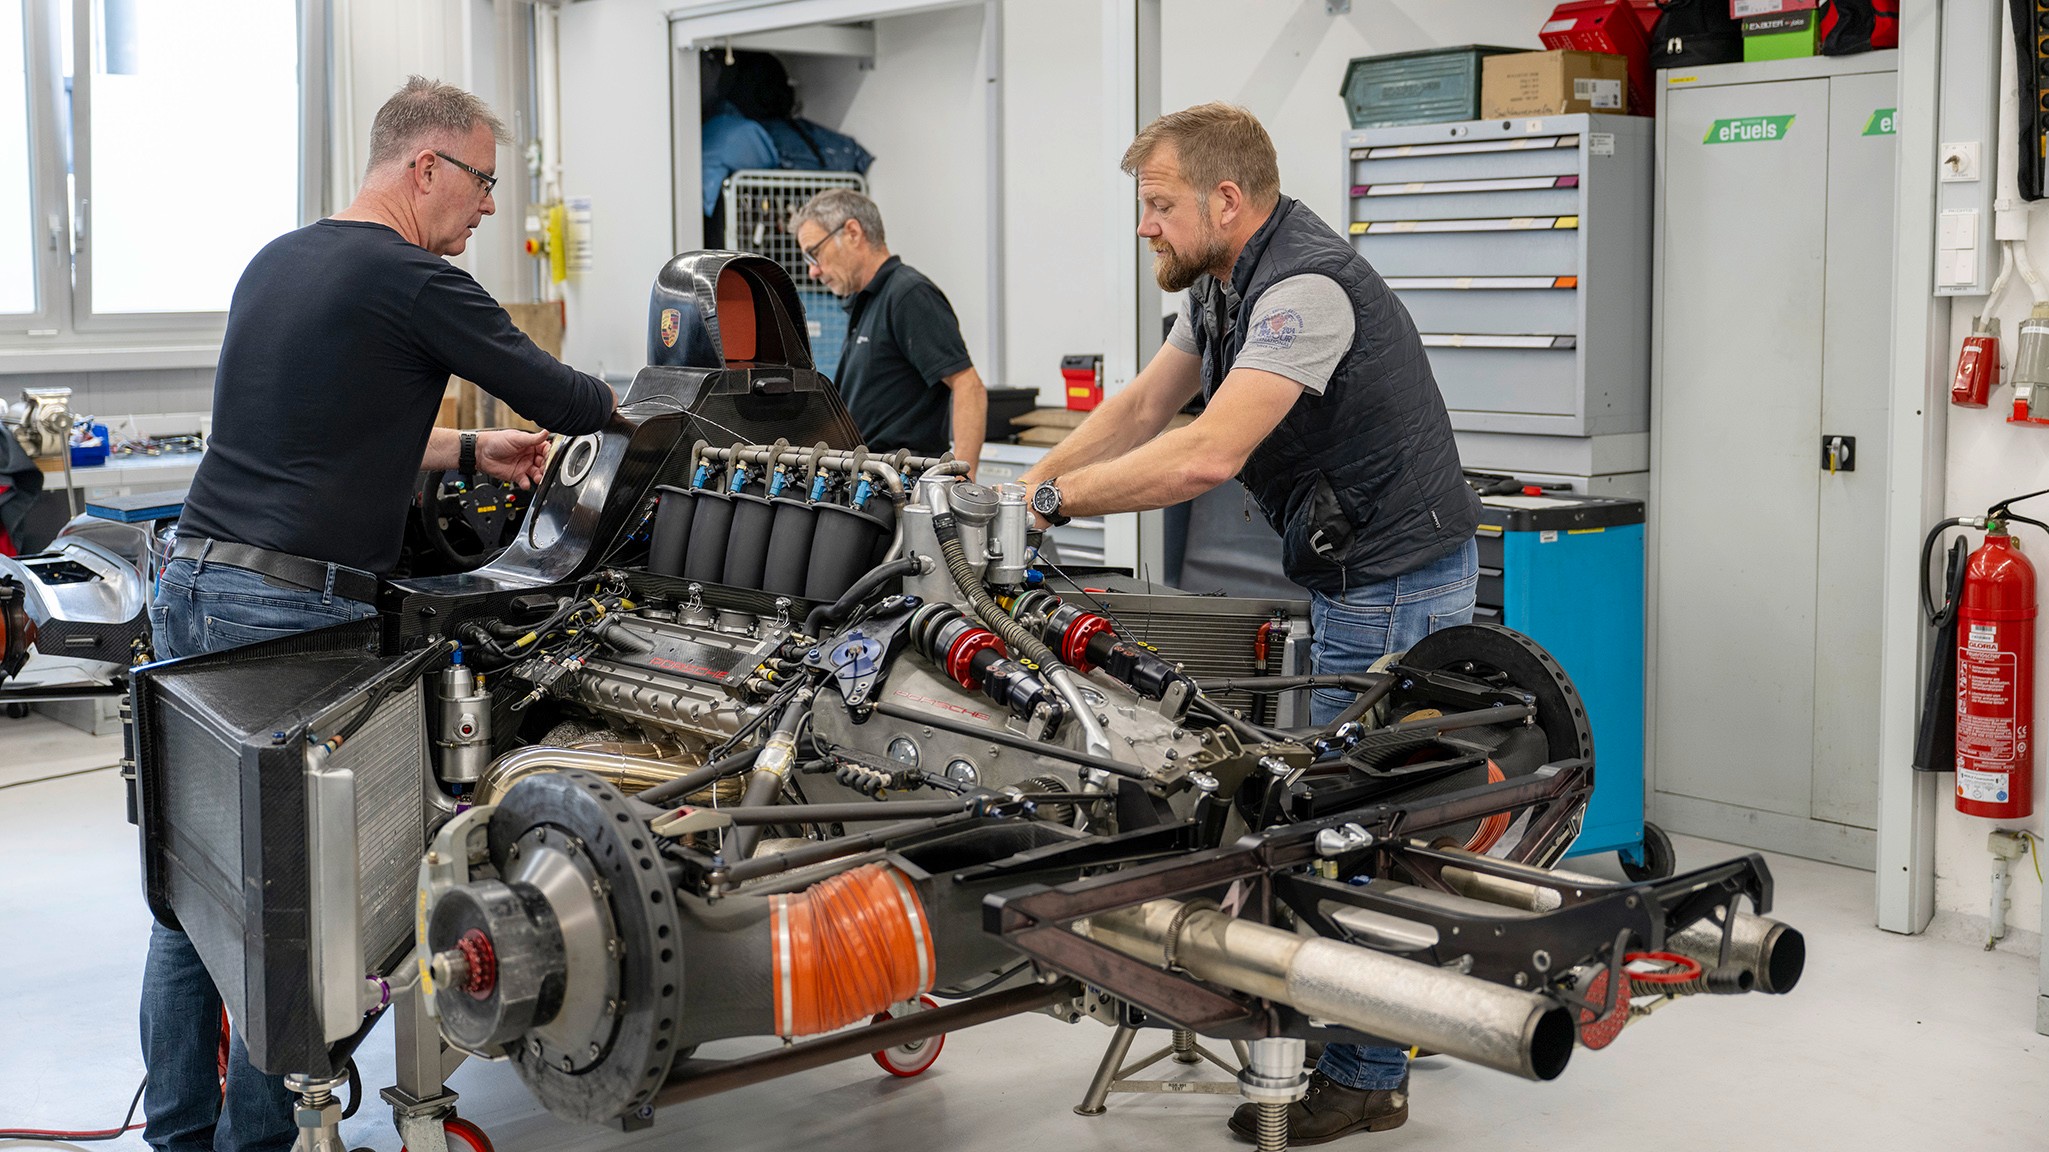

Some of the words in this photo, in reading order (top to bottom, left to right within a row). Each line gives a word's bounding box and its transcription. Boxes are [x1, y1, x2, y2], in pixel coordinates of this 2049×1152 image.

[1719, 119, 1777, 141] eFuels
[1969, 641, 1997, 650] GLORIA
[648, 656, 730, 680] PORSCHE
[893, 689, 991, 721] PORSCHE
